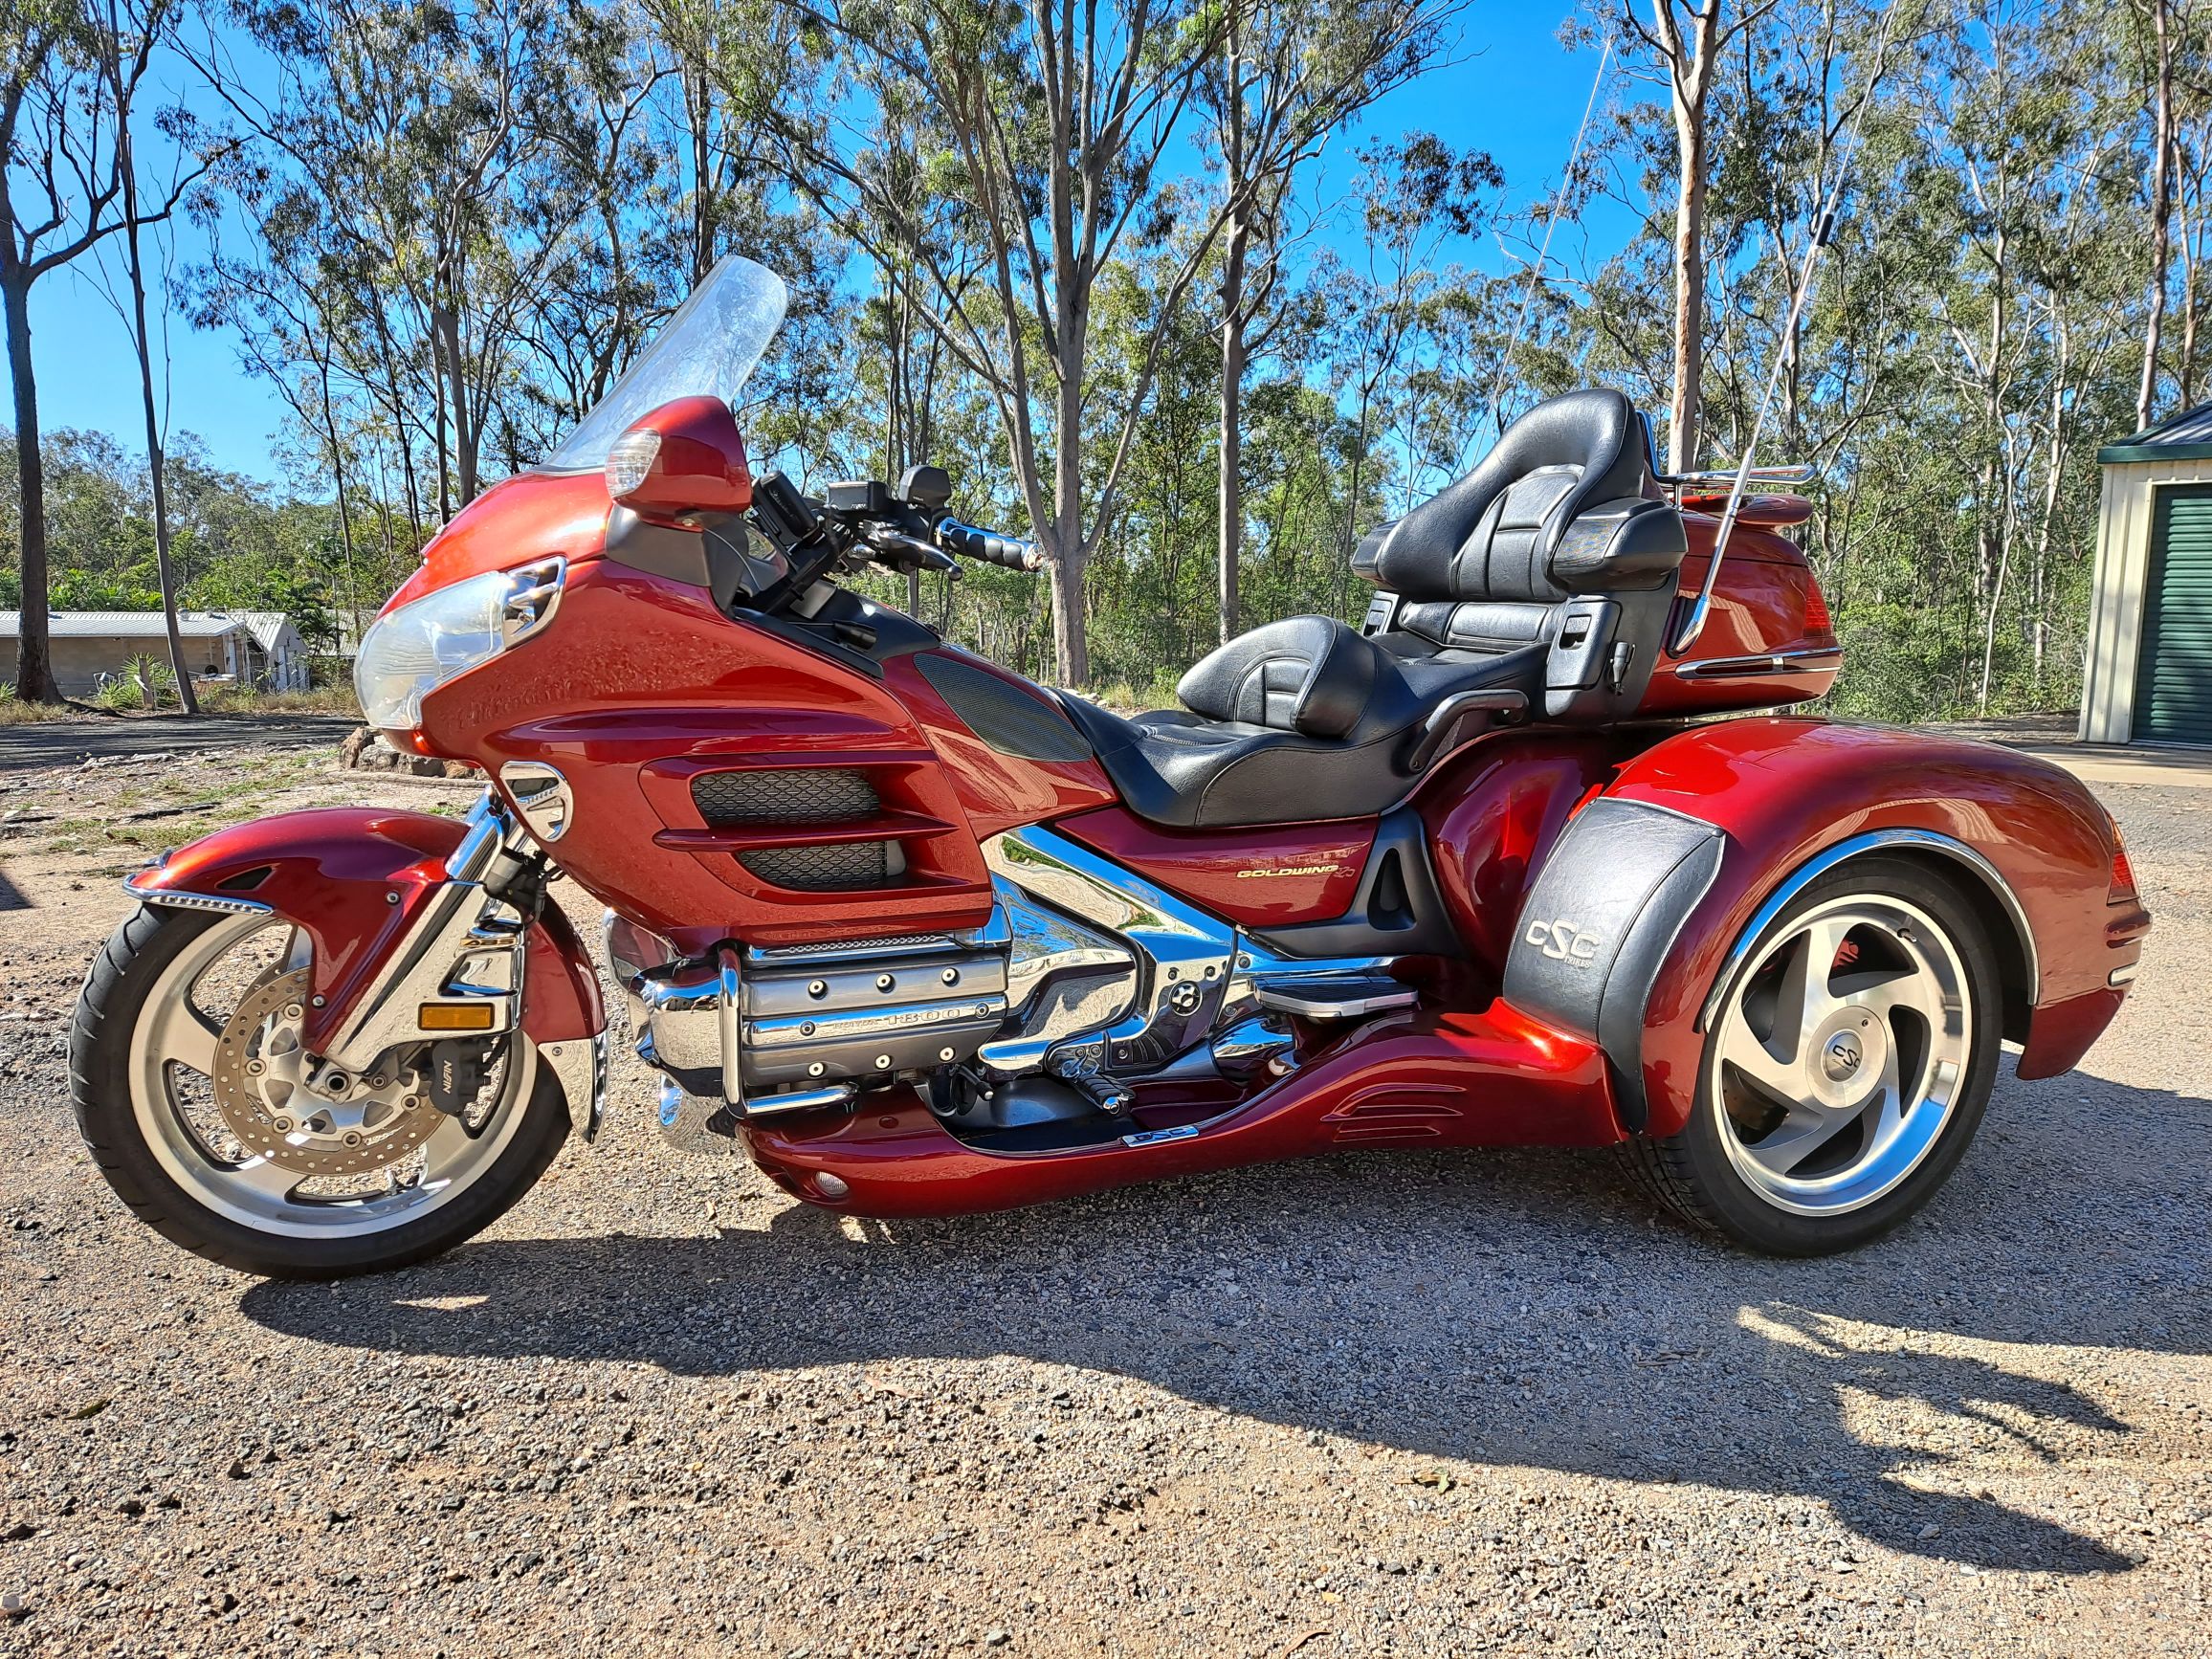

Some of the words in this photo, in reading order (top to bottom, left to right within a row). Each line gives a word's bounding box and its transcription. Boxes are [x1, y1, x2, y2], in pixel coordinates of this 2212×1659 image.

[1236, 864, 1339, 878] GOLDWING
[1564, 955, 1592, 968] TRIKES
[886, 1008, 960, 1025] 1800
